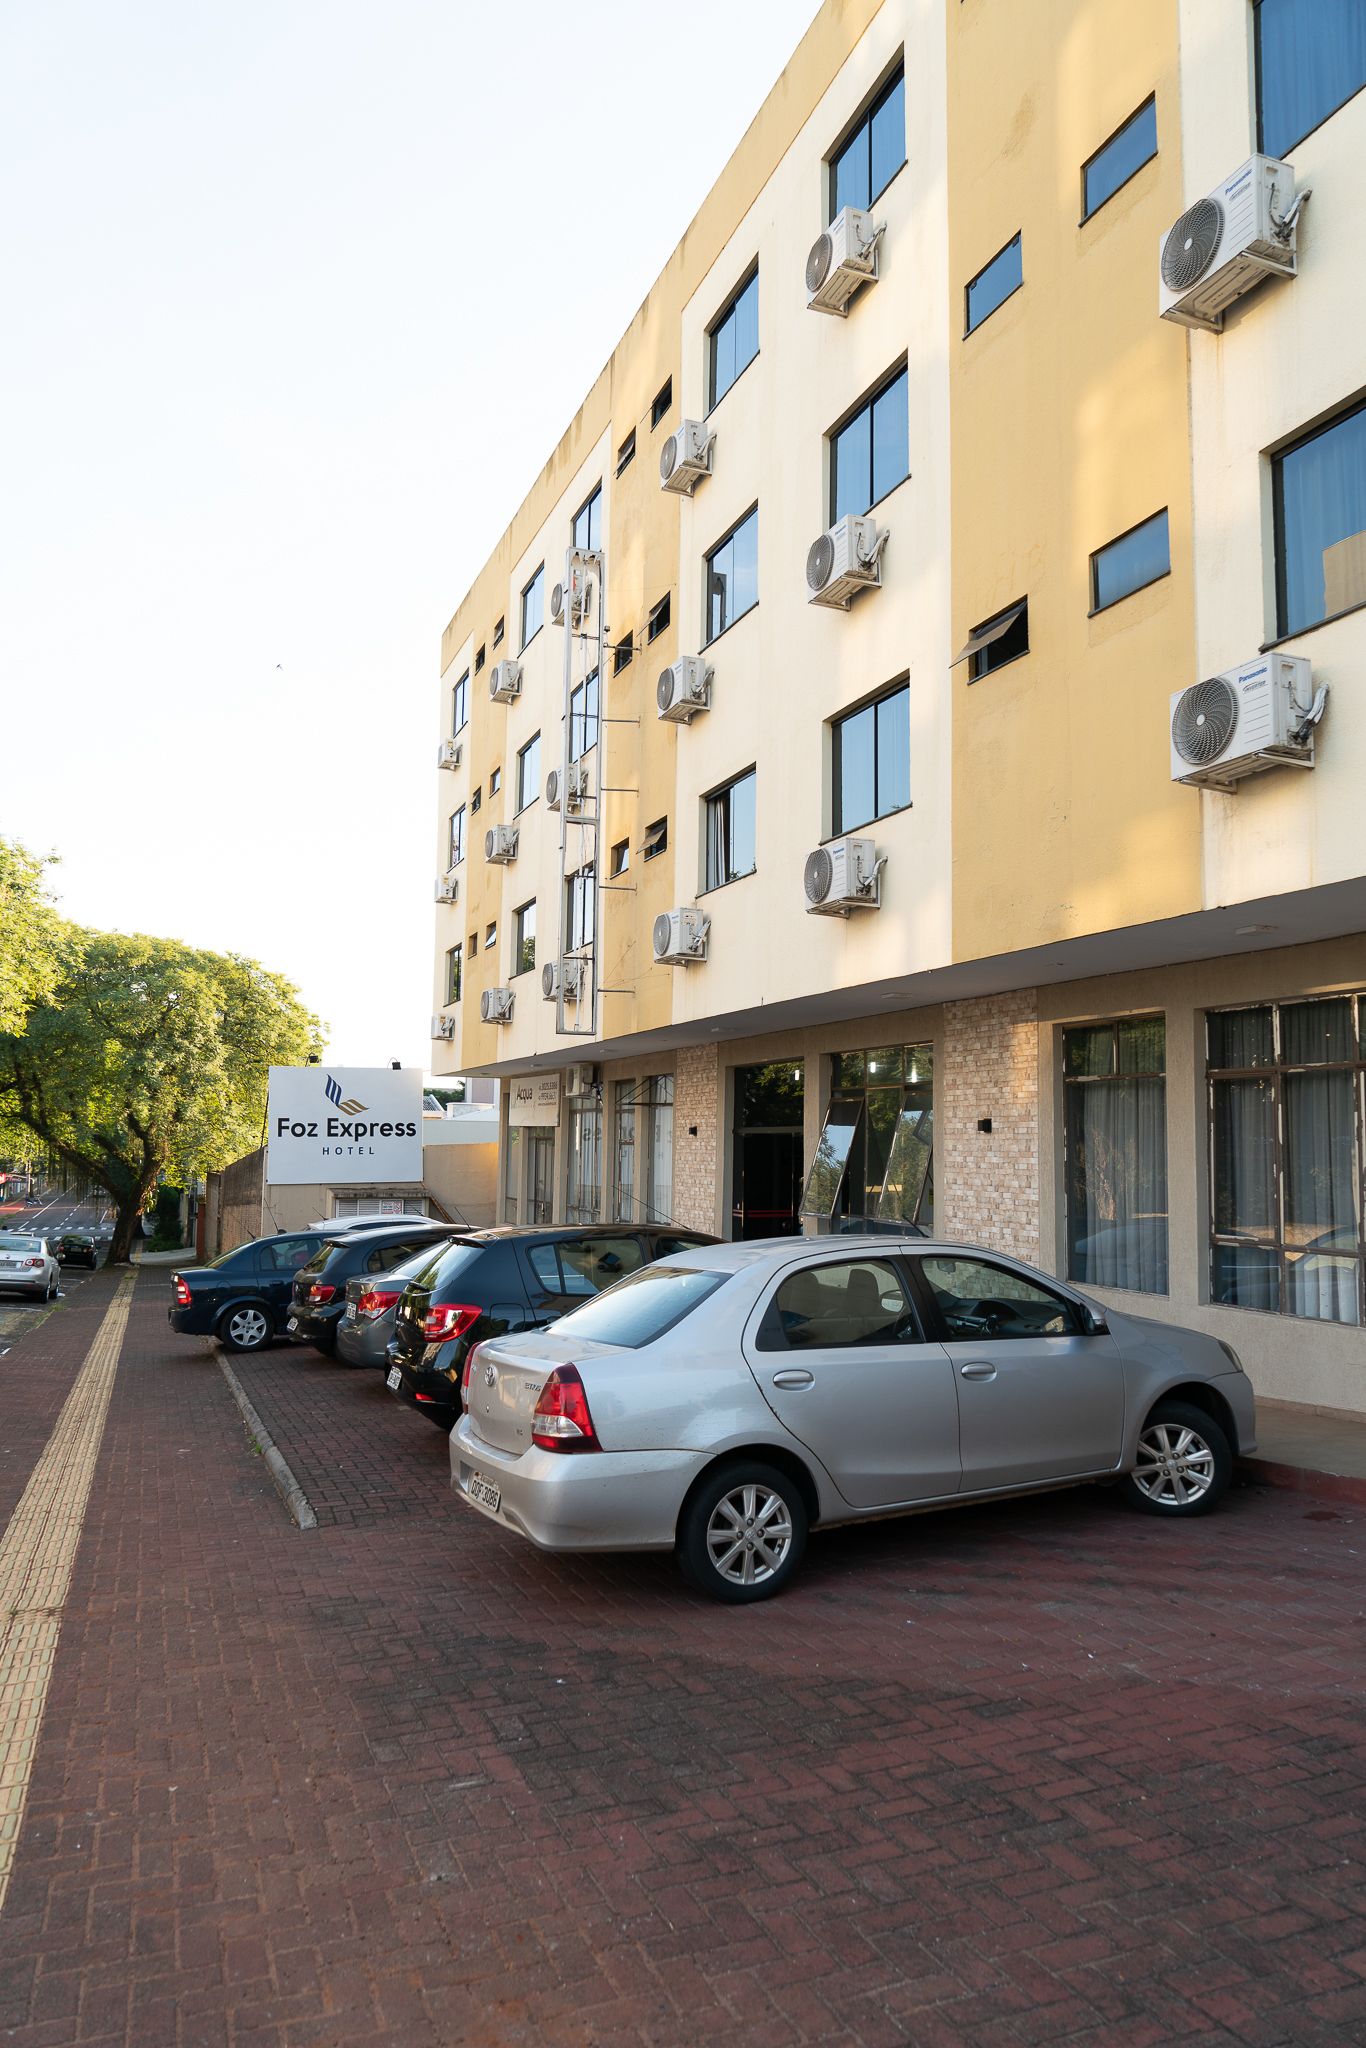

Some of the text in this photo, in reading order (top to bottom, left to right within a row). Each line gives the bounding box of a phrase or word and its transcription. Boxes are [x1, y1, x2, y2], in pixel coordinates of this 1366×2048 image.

[1239, 667, 1268, 683] Panasonic
[517, 1084, 533, 1104] Acqua
[277, 1118, 417, 1142] Foz Express
[322, 1147, 375, 1156] HOTEL
